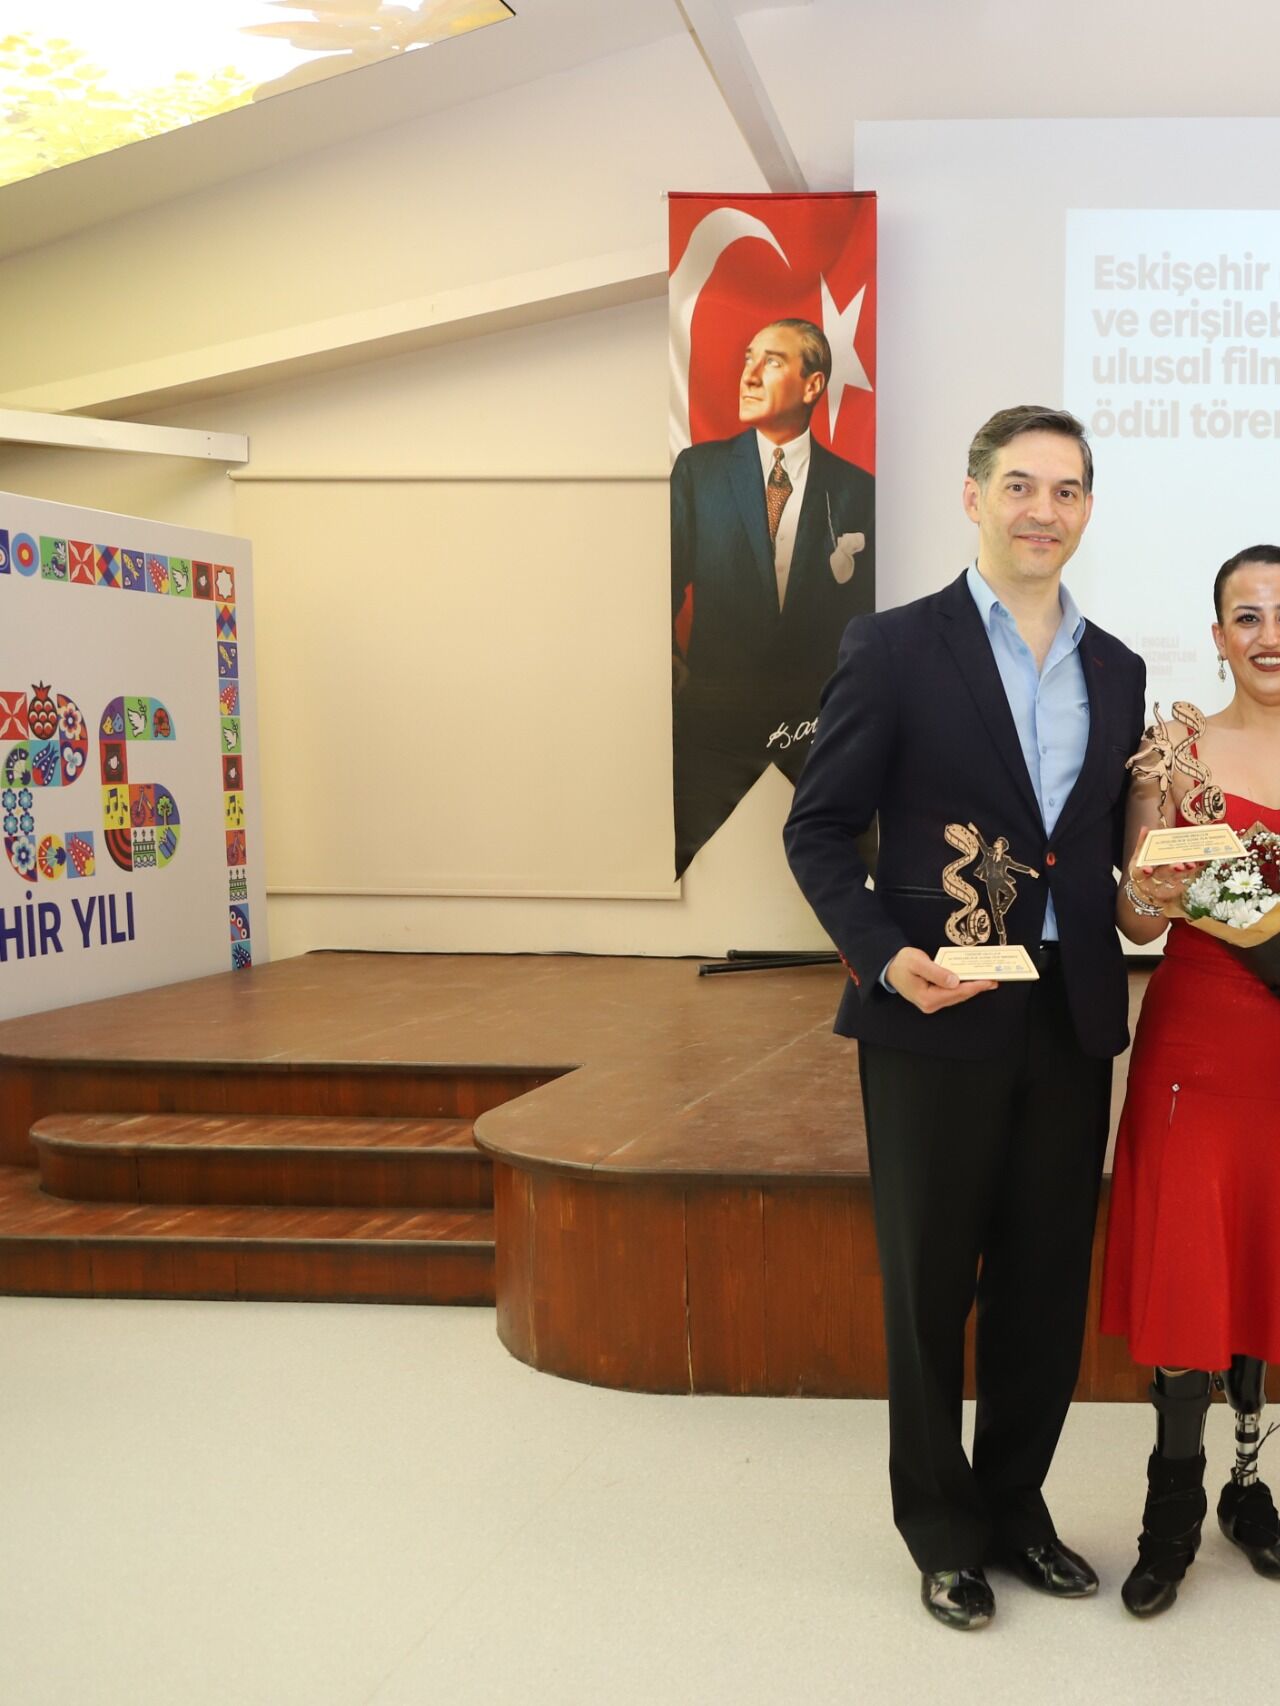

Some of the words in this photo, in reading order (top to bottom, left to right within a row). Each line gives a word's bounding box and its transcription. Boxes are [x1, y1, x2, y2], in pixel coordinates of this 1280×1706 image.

[1093, 251, 1271, 296] Eskişehir
[1091, 307, 1139, 338] ve
[1092, 346, 1212, 385] ulusal
[1091, 398, 1180, 438] ödül
[0, 890, 64, 962] HİR
[71, 892, 135, 948] YILI
